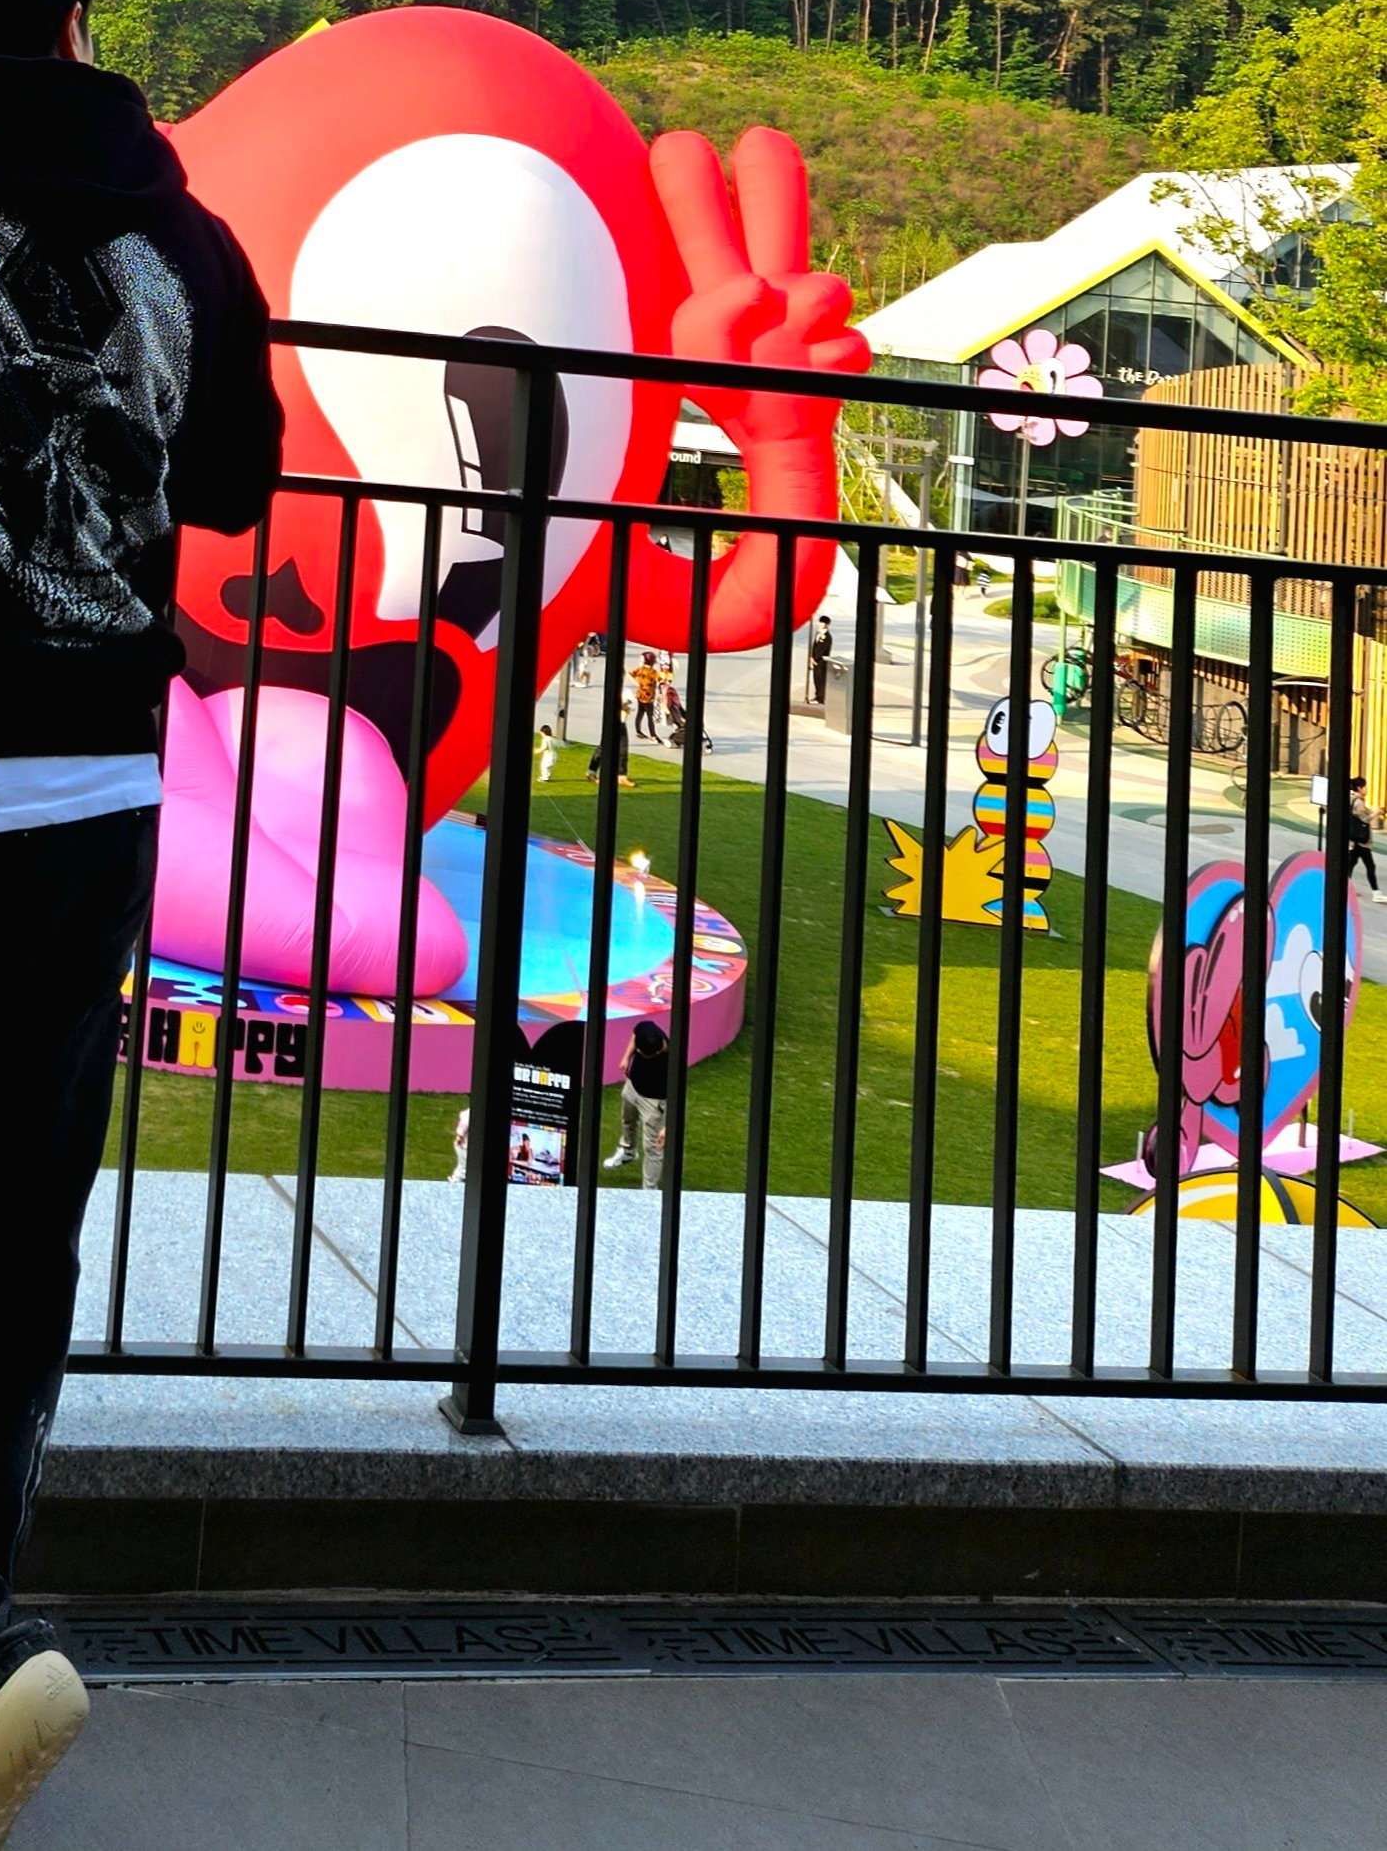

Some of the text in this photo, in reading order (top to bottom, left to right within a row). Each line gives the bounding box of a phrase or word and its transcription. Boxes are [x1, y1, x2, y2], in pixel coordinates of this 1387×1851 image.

[135, 1625, 546, 1656] TIME VILLAS
[689, 1627, 1078, 1656] TIME VILLAS
[1199, 1628, 1365, 1658] TIME
